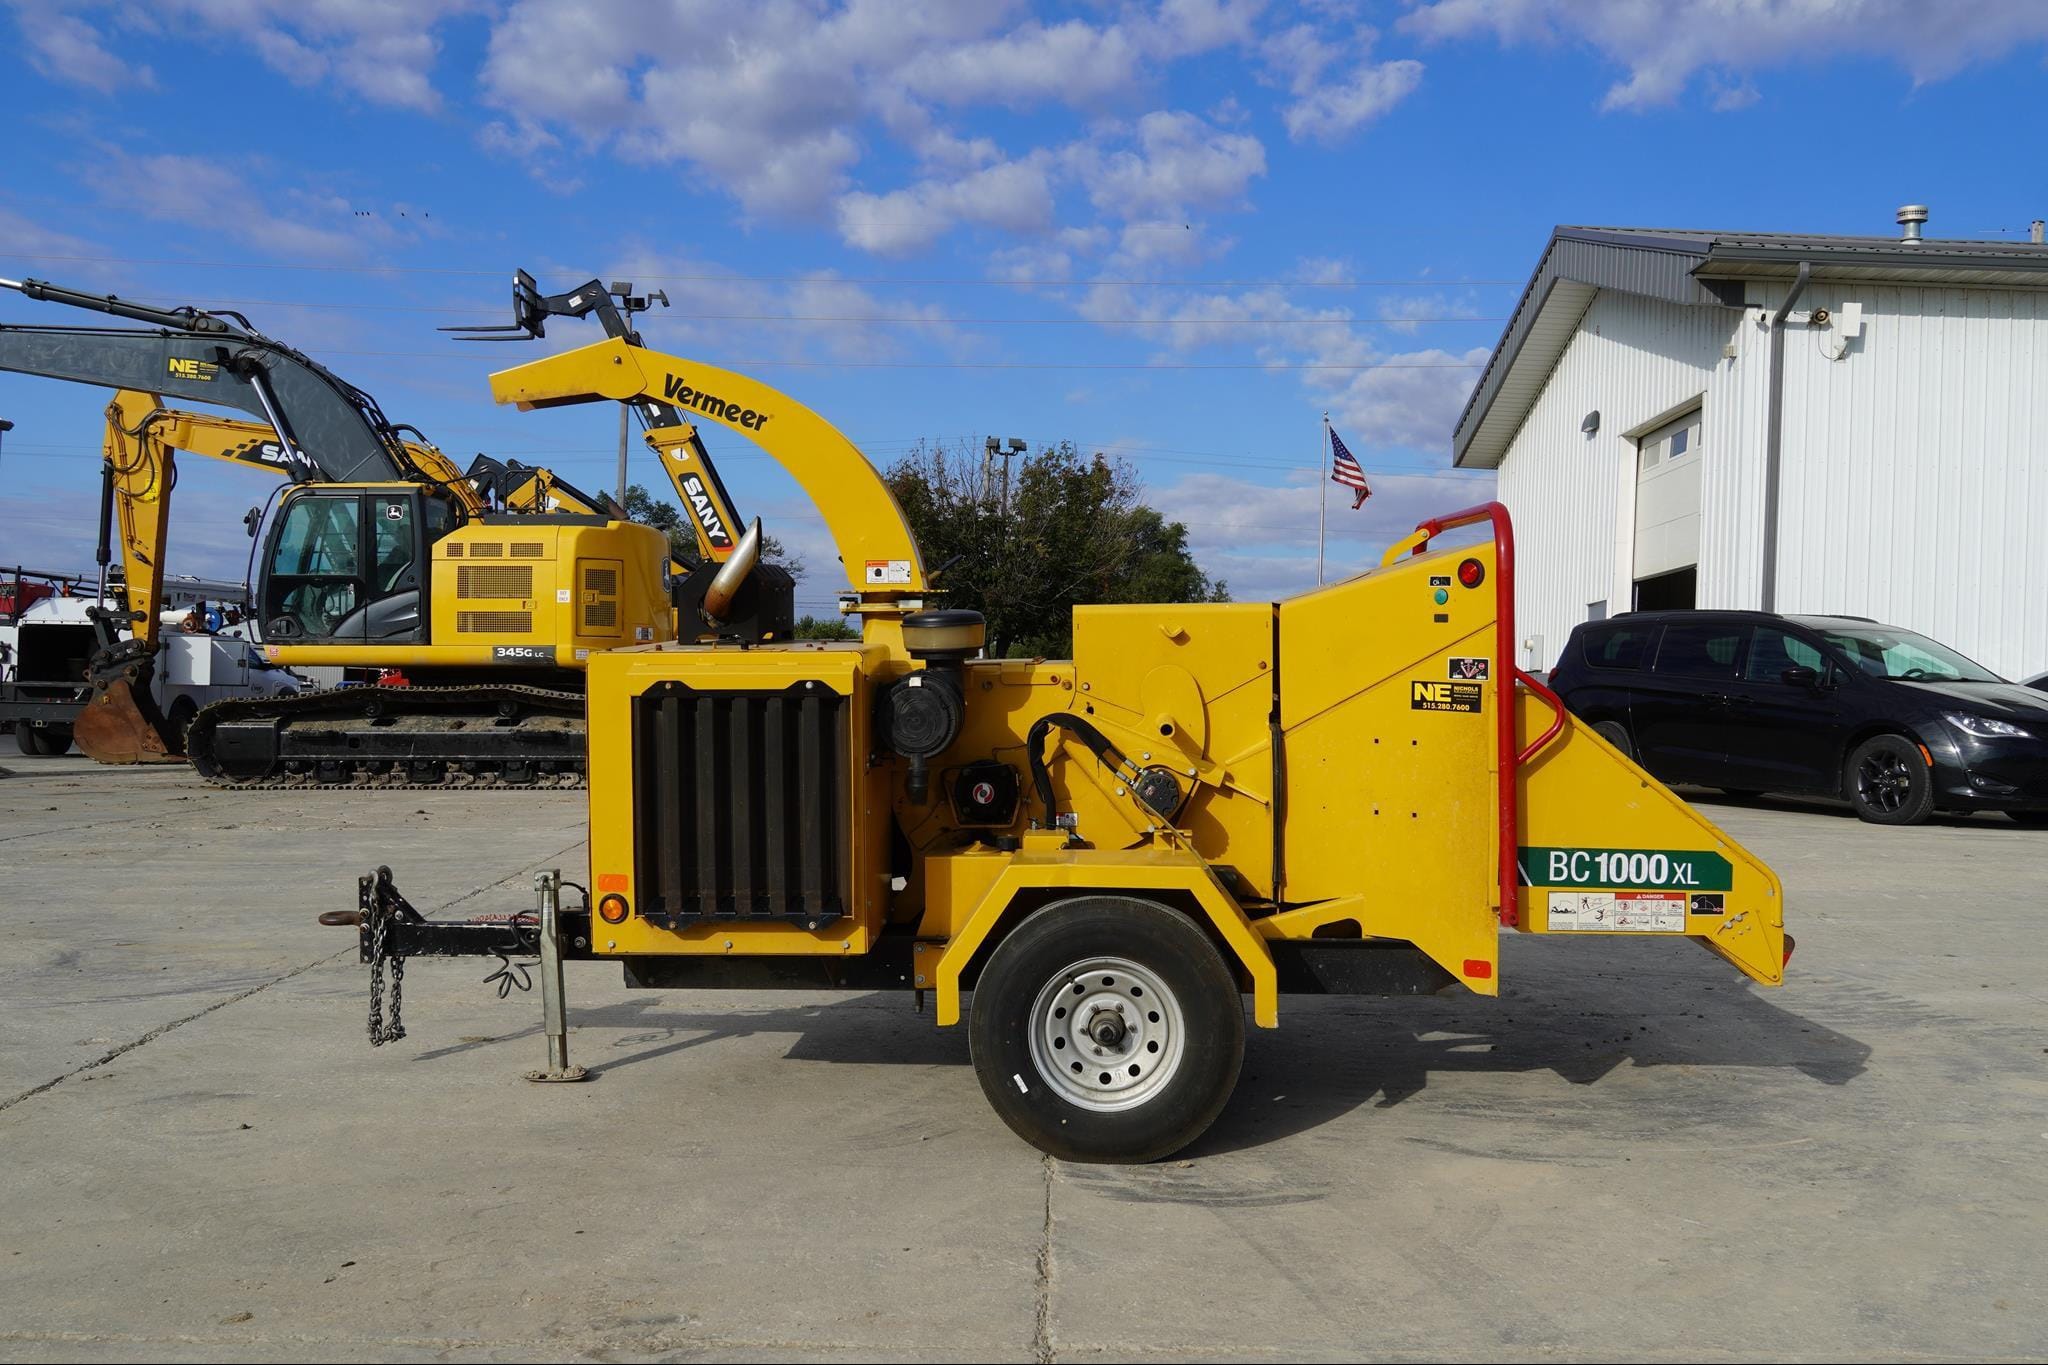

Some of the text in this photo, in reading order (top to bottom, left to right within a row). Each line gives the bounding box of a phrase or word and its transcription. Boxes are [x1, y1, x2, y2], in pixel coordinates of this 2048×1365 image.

[169, 358, 199, 374] NE
[664, 373, 768, 432] Vermeer
[261, 444, 319, 469] SAN
[683, 477, 727, 538] SANY
[497, 647, 533, 657] 345G
[1414, 682, 1452, 702] NE
[1422, 702, 1470, 711] 515.280.7600
[1549, 851, 1700, 885] BC 1000 XL
